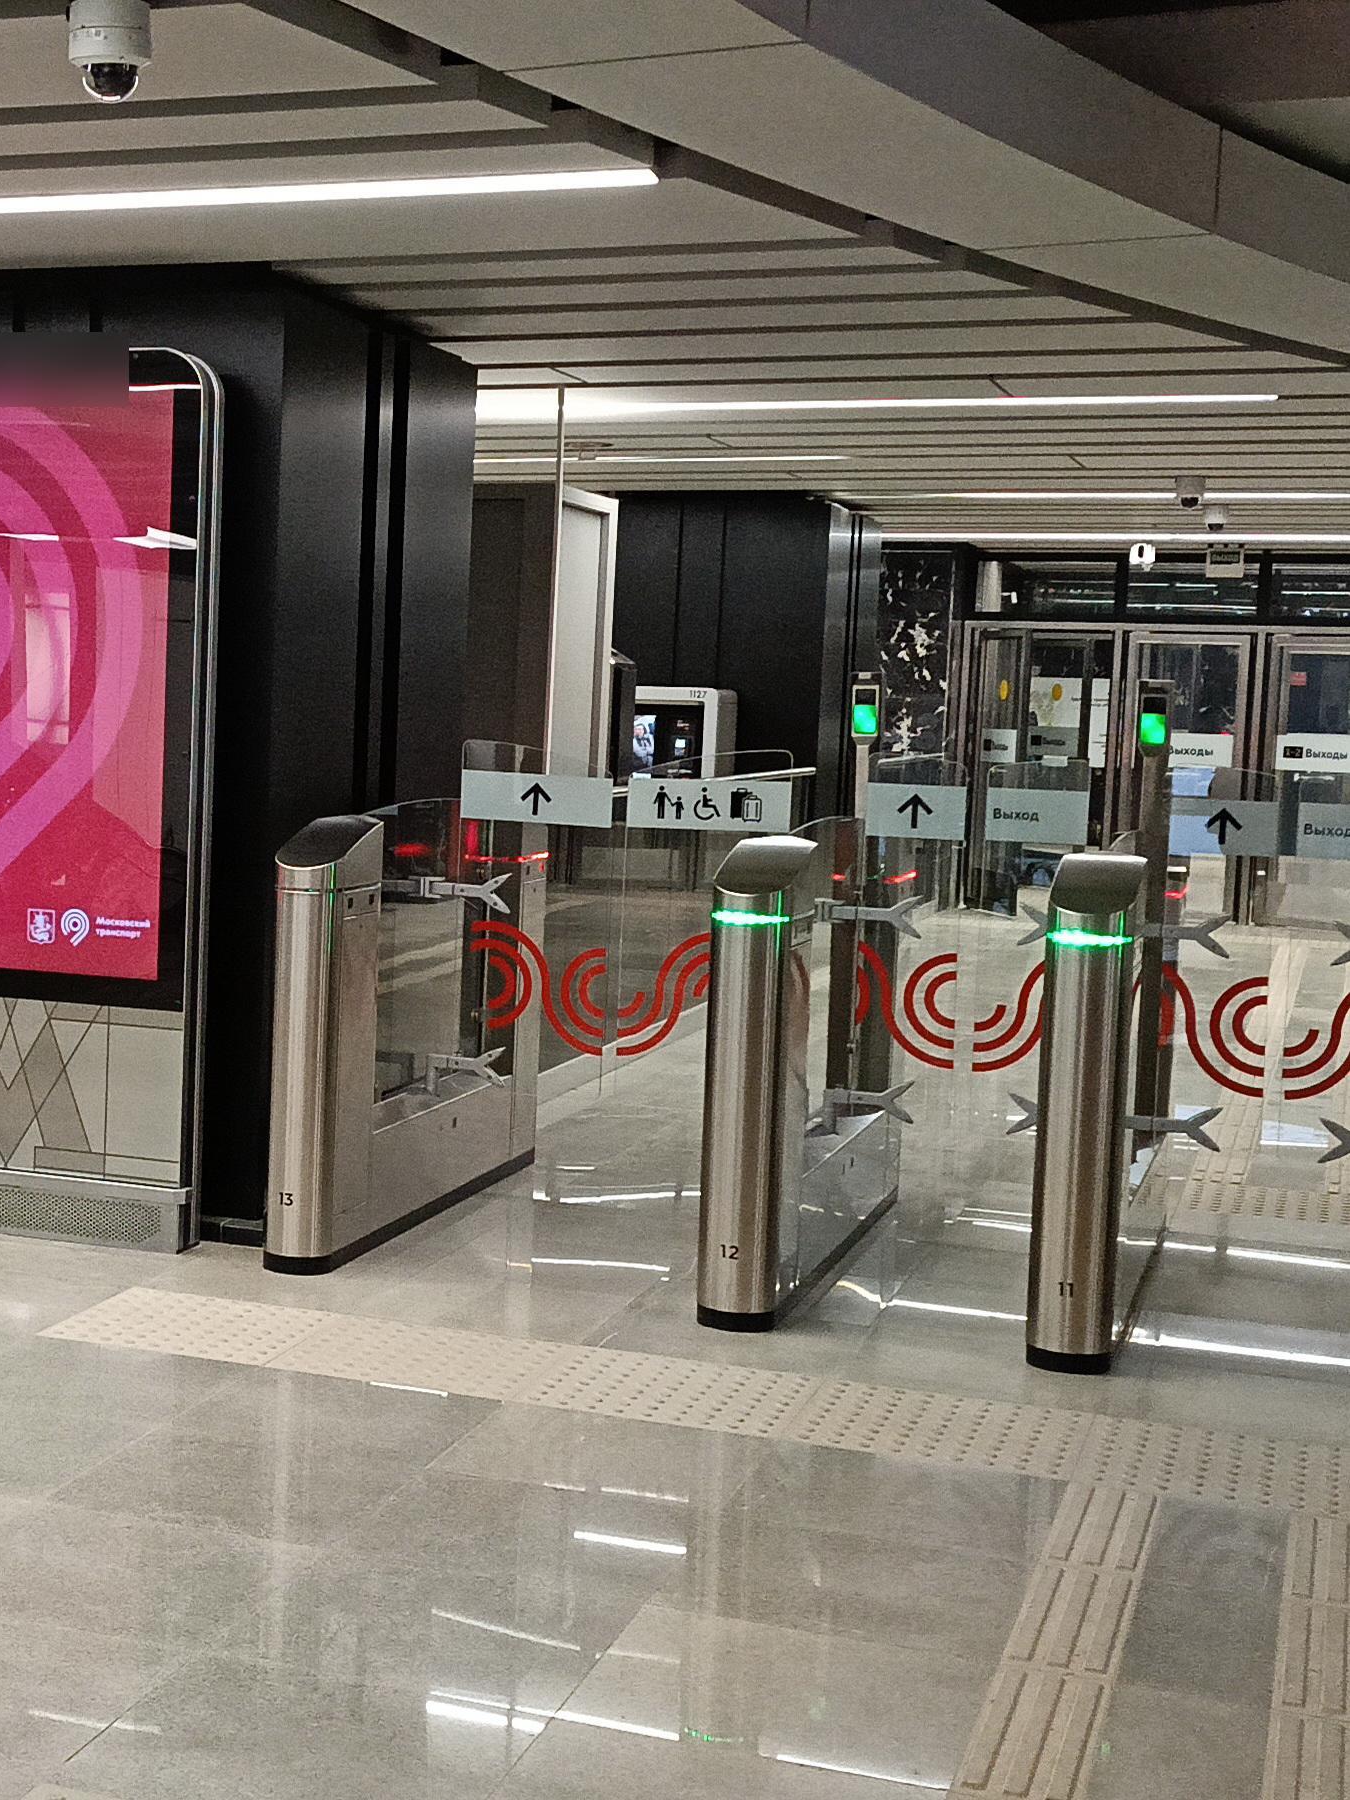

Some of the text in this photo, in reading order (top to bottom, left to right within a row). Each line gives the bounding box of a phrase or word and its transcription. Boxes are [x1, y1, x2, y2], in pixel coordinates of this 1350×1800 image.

[689, 690, 707, 699] 1127
[1305, 748, 1348, 760] Выходы
[992, 807, 1040, 822] Выход
[95, 916, 151, 928] Московский
[95, 928, 141, 939] транспорт
[279, 1191, 294, 1207] 13
[720, 1244, 739, 1260] 12
[1058, 1282, 1074, 1298] 11
